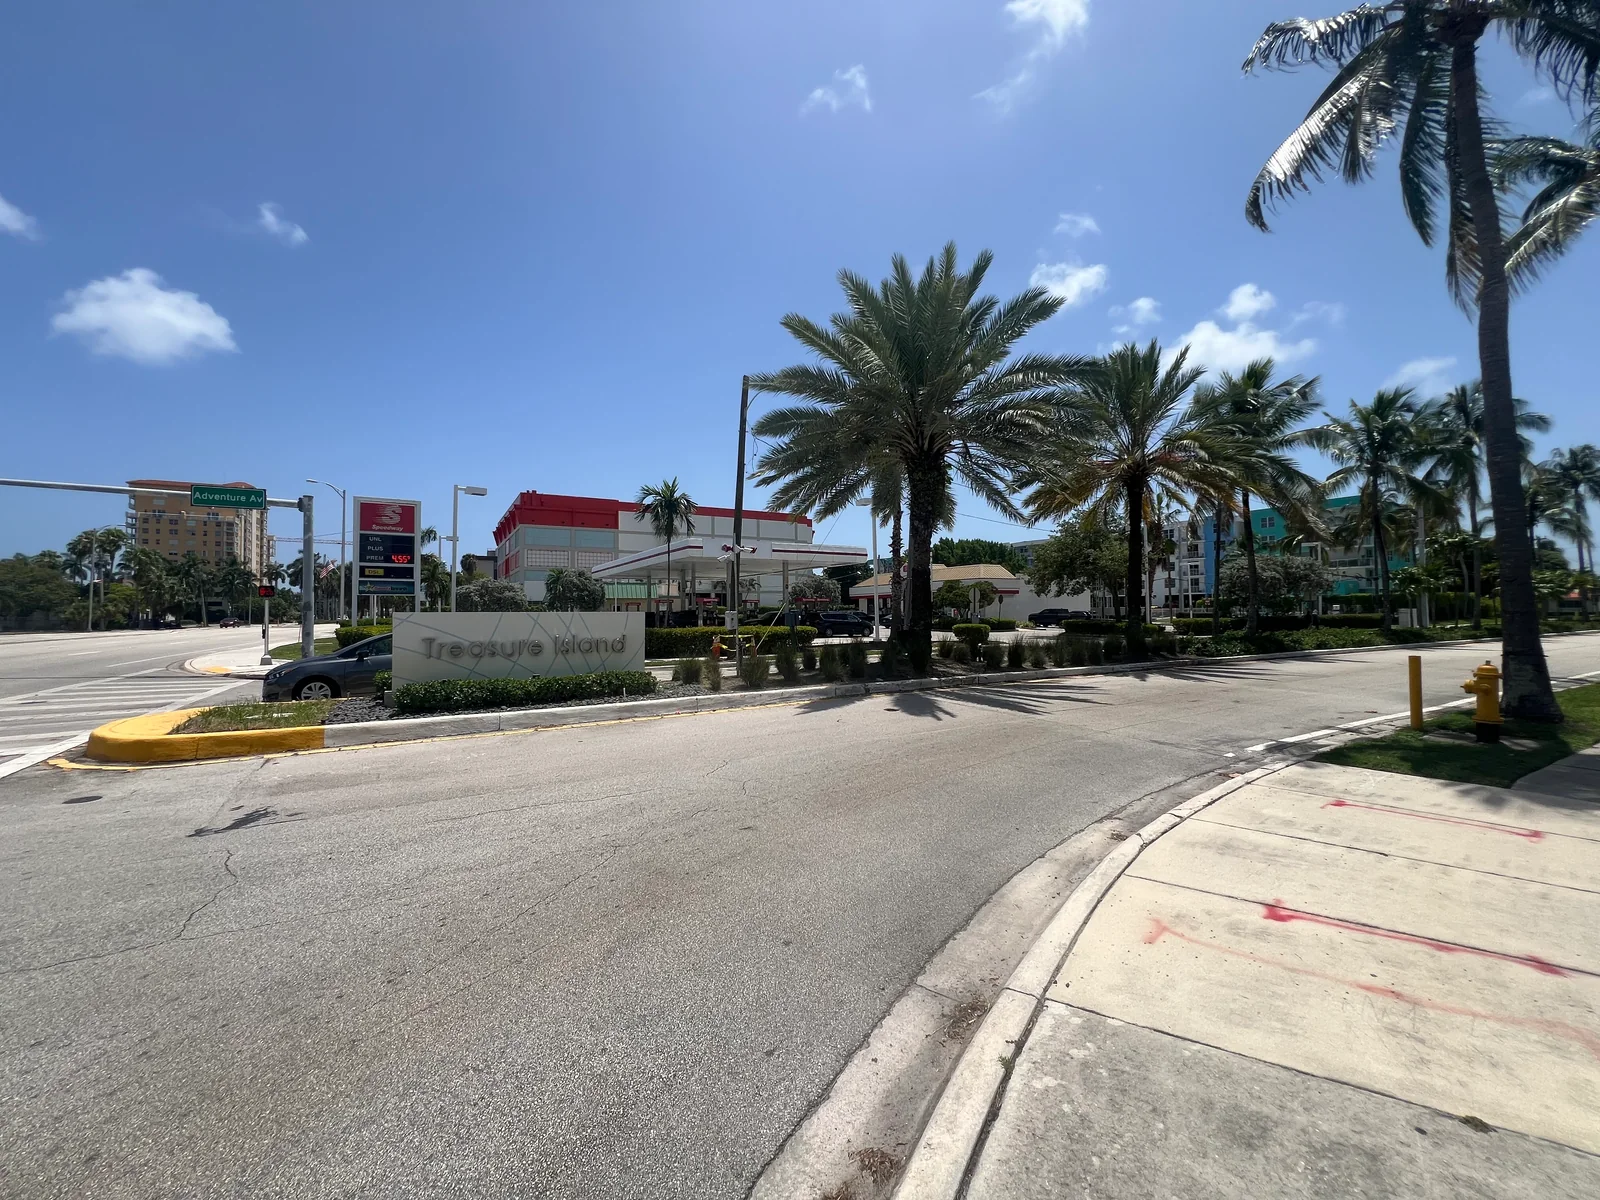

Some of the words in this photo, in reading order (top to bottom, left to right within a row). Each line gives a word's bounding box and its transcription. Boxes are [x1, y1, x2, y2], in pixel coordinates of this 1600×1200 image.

[193, 491, 246, 502] Adventure
[249, 495, 263, 503] Av
[372, 524, 404, 532] Speedway
[421, 637, 545, 660] Treasure
[554, 634, 627, 655] Island
